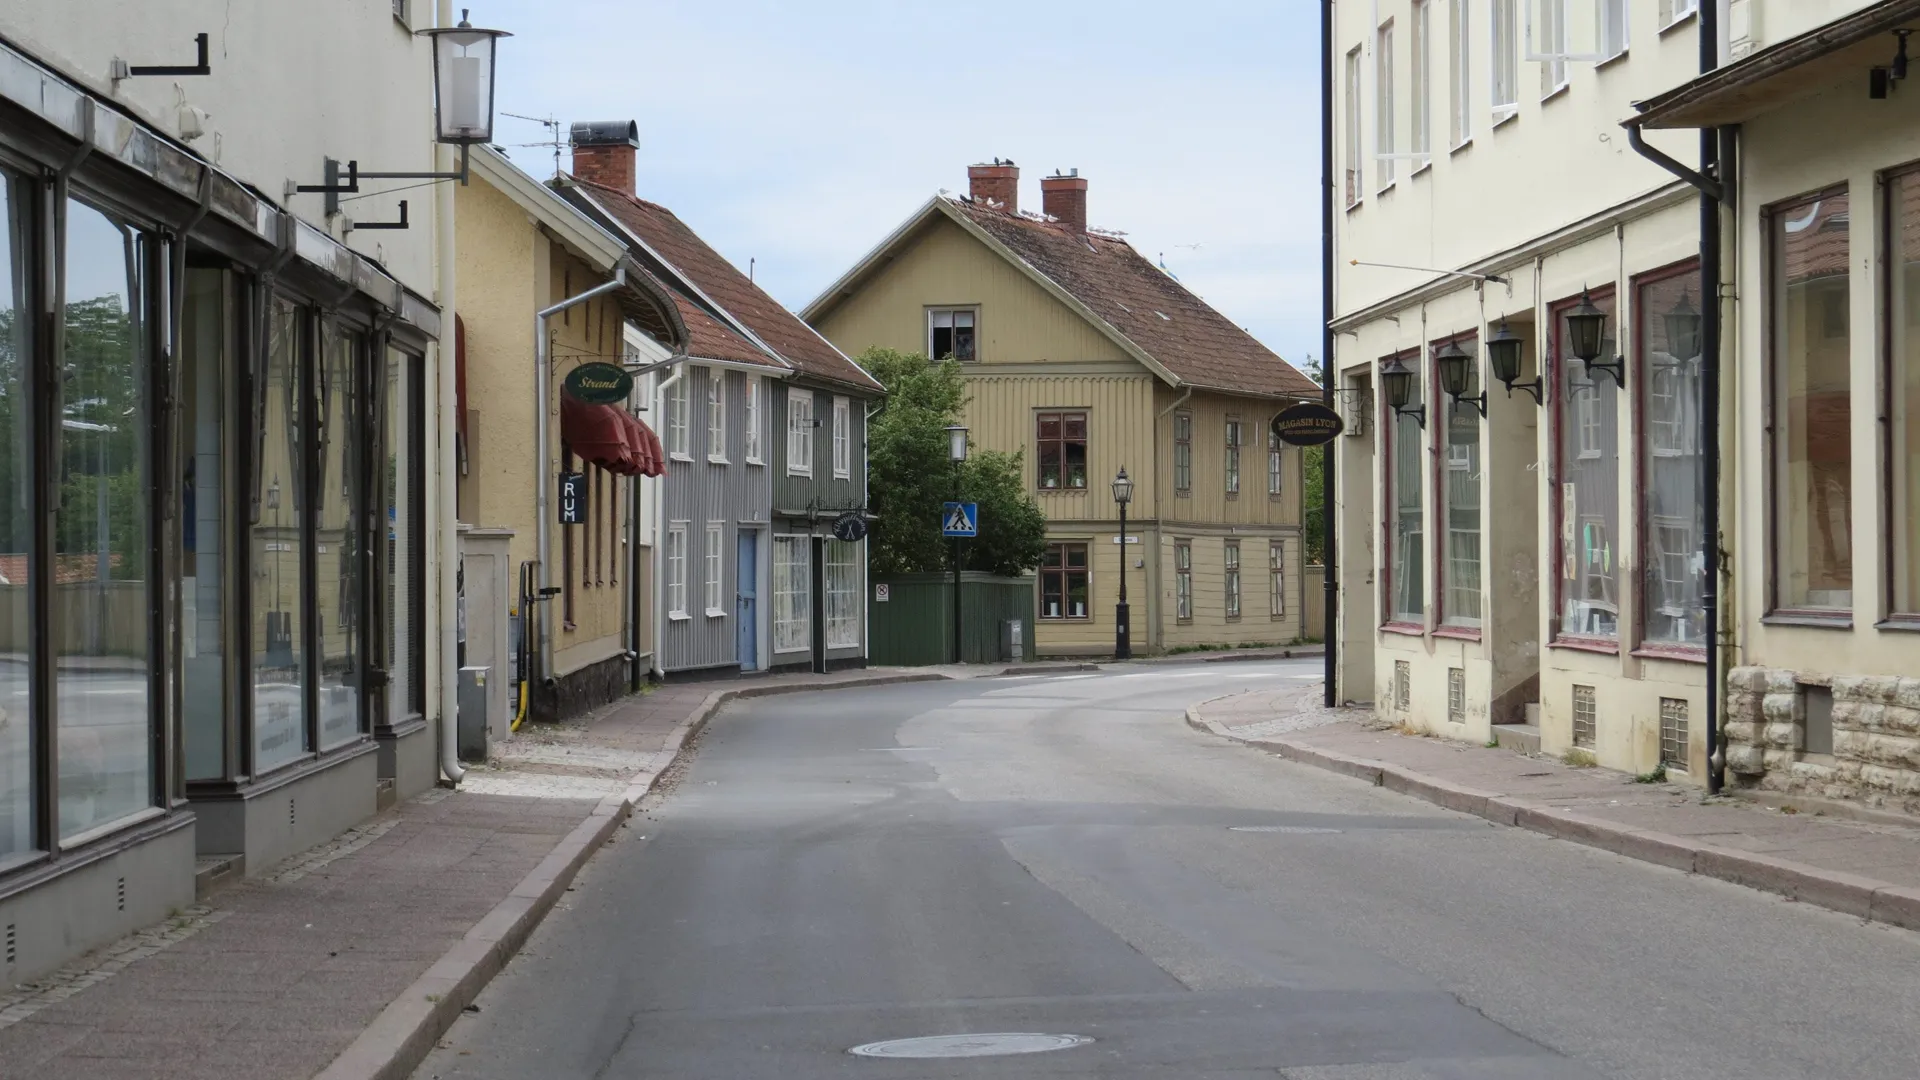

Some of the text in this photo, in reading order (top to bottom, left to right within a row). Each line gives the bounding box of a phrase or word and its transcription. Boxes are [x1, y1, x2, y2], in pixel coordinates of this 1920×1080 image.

[578, 376, 620, 389] Strand
[1278, 417, 1337, 431] MAGASIN LYON
[564, 482, 575, 522] RUM
